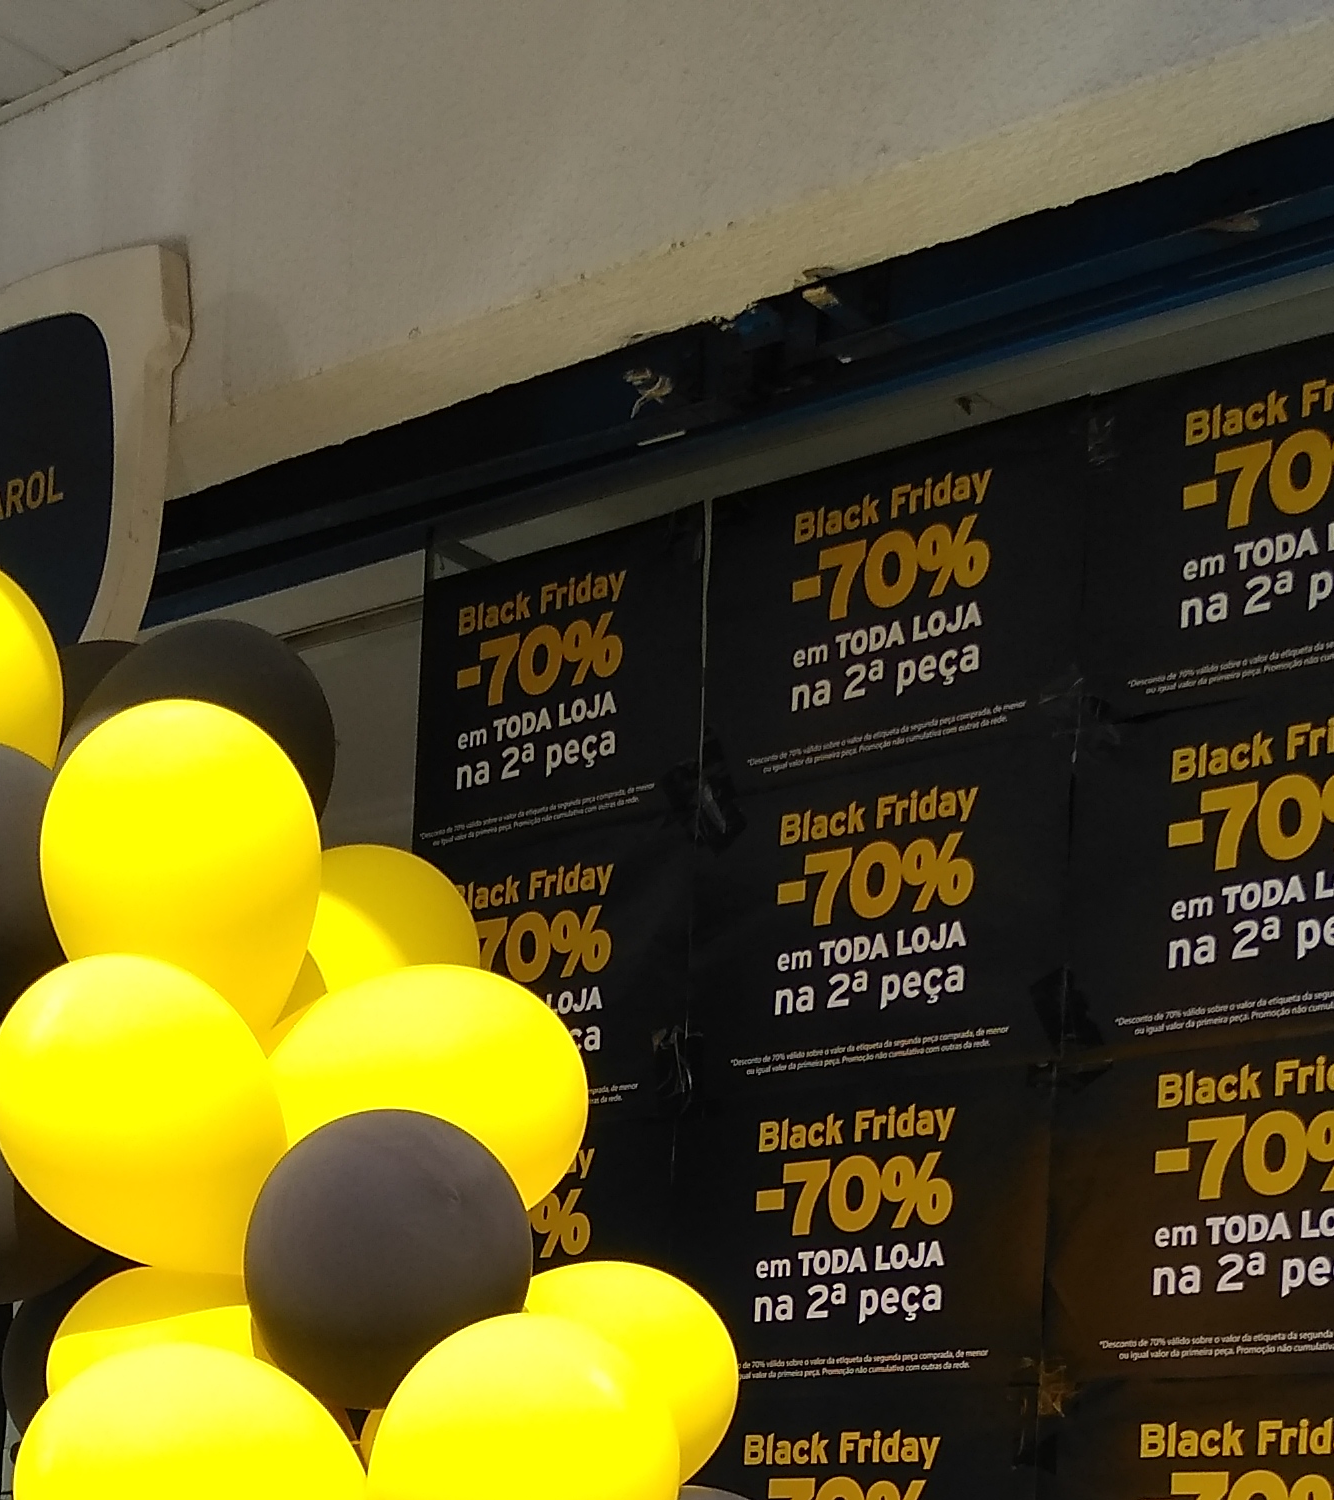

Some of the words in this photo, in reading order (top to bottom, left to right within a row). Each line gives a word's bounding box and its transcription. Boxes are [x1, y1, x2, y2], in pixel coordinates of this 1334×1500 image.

[1185, 390, 1289, 446] Black
[1182, 554, 1225, 581] em
[1233, 527, 1319, 571] TODA
[458, 590, 531, 637] Black
[540, 569, 627, 614] Friday
[1180, 592, 1228, 629] na
[456, 611, 624, 707] -70%
[457, 728, 487, 750] em
[492, 707, 552, 742] TODA
[558, 690, 617, 727] LOJA
[456, 760, 490, 791] na
[545, 730, 616, 778] peça
[758, 1113, 845, 1153] Black
[854, 1103, 956, 1143] Friday
[755, 1150, 954, 1237] -70%
[755, 1258, 791, 1279] em
[797, 1246, 868, 1277] TODA
[874, 1240, 945, 1271] LOJA
[754, 1294, 794, 1323] na
[858, 1284, 942, 1325] peça
